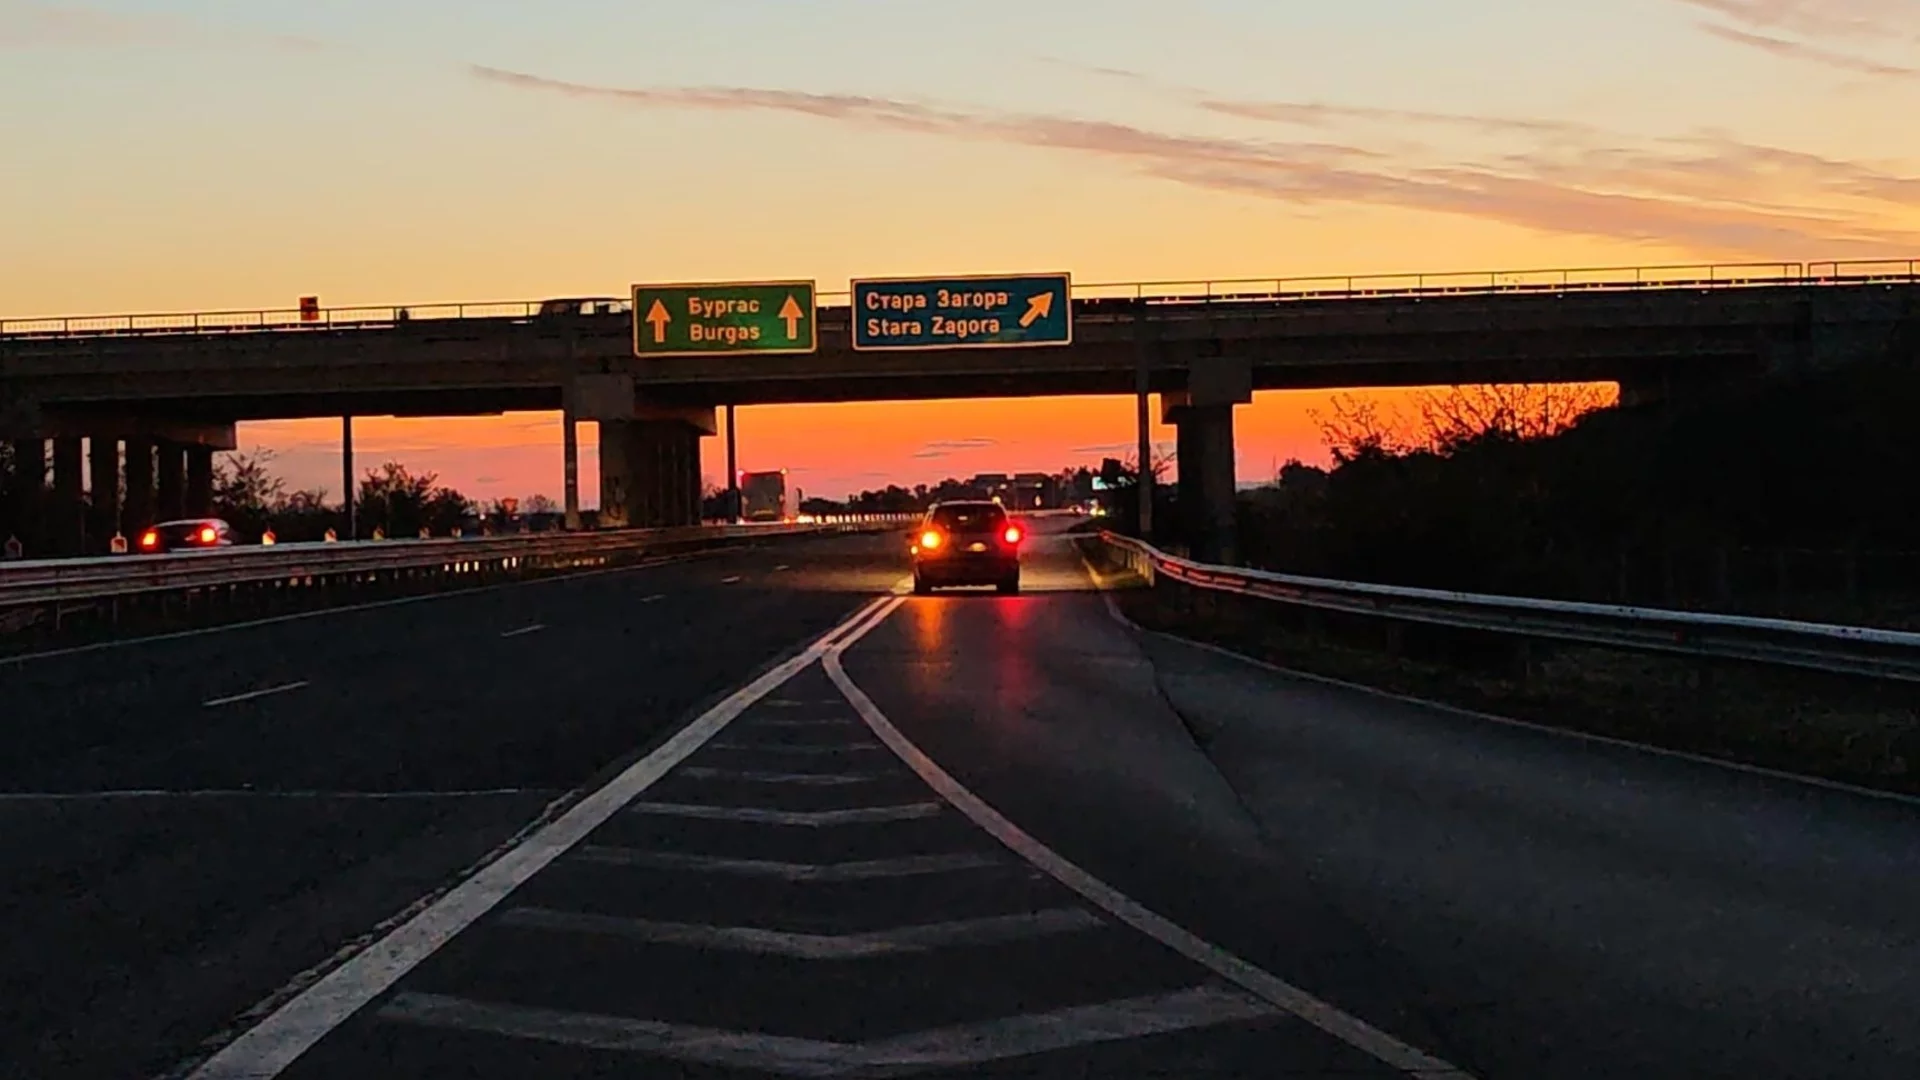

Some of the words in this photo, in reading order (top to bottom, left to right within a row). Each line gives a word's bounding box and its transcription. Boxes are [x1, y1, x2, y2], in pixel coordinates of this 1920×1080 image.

[688, 297, 759, 317] Бургас
[866, 292, 927, 313] Стара
[937, 289, 1008, 310] Загора
[690, 323, 760, 345] Burgas
[868, 318, 923, 336] Stara
[932, 316, 1000, 338] Zagora
